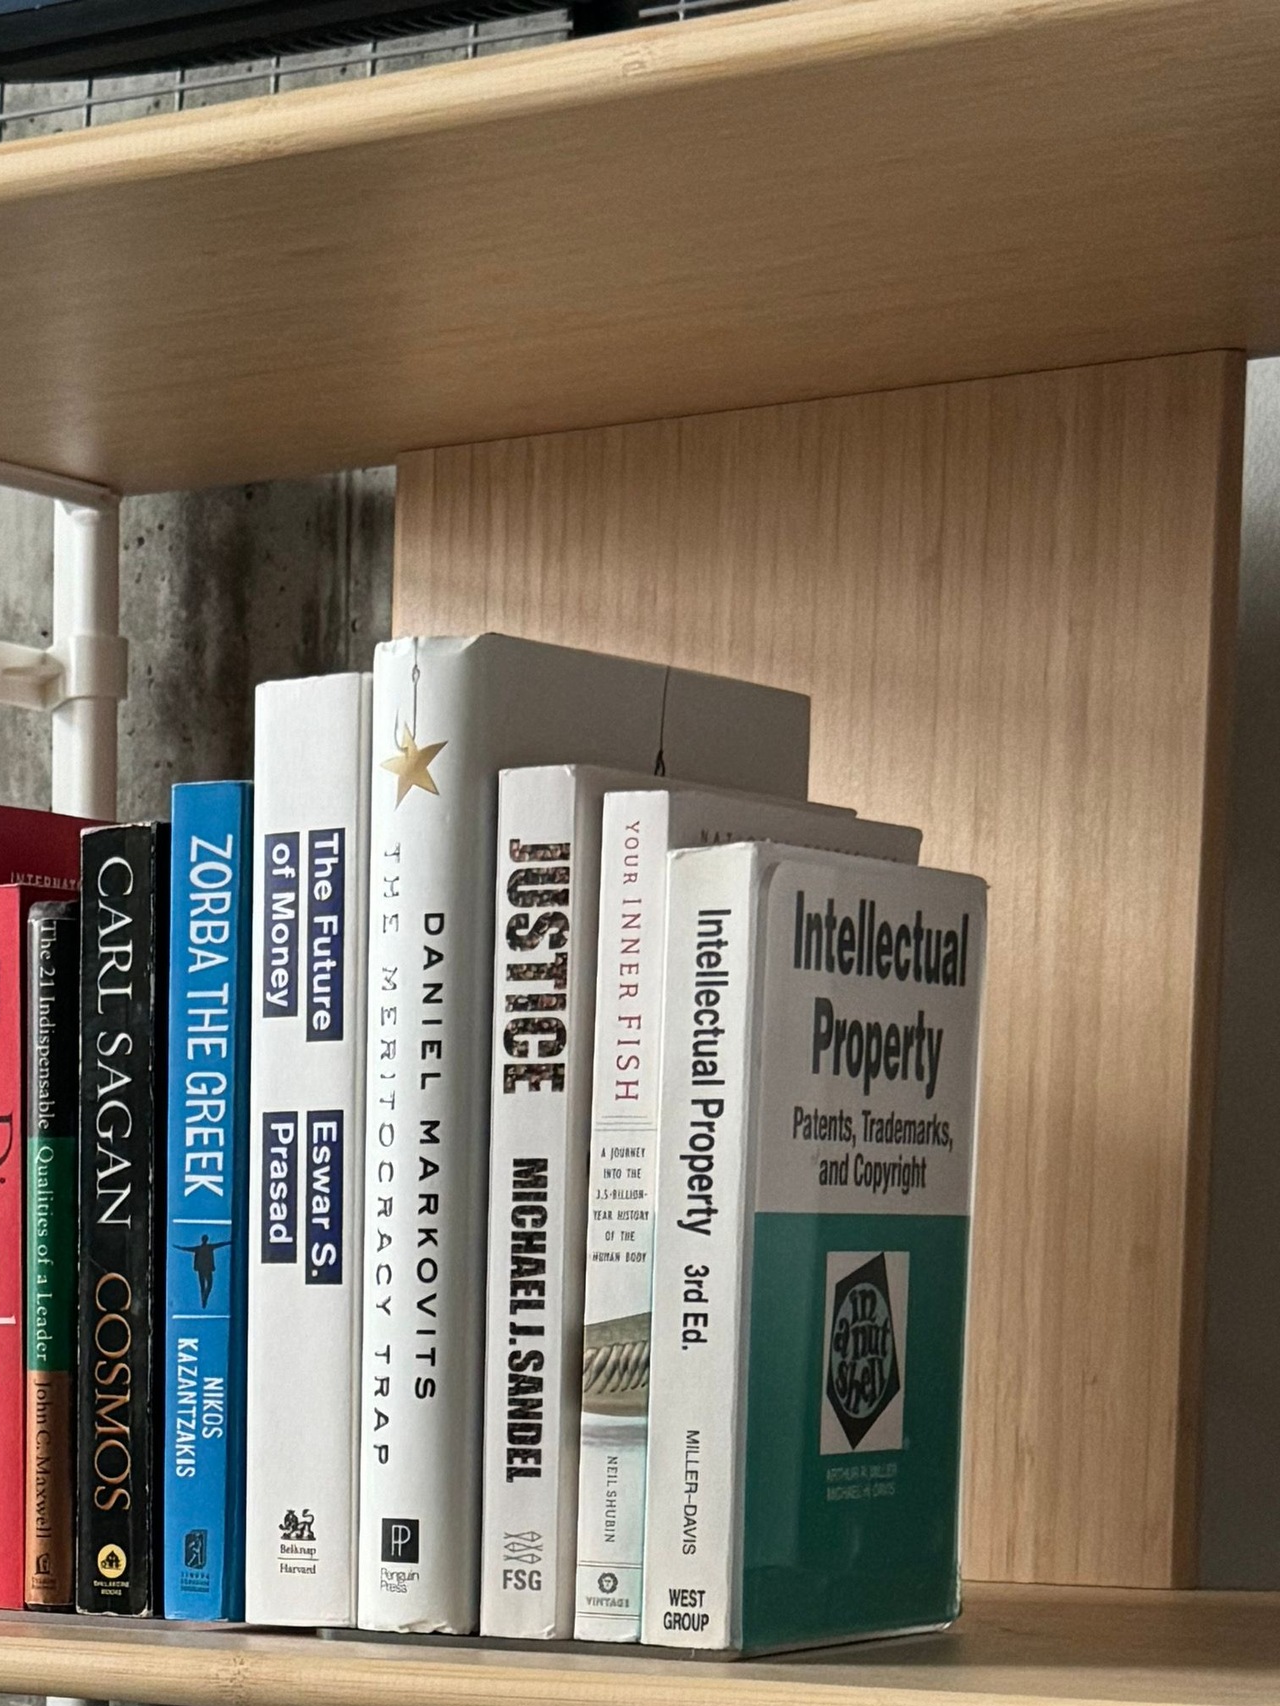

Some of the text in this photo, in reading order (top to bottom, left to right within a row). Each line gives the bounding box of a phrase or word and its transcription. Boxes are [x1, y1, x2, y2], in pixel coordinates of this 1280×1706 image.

[266, 843, 296, 1008] of Money
[312, 832, 339, 1031] The Future
[502, 838, 571, 1095] JUSTICE
[615, 820, 643, 1102] YOUR INNER FISH
[793, 889, 970, 988] Intellectual
[96, 856, 134, 1229] CARL SAGAN
[184, 834, 233, 1198] ZORBA THE GREEK
[812, 997, 943, 1100] Property
[35, 919, 58, 1362] The 21 Indispensable Qualities of a Leader
[372, 843, 402, 1466] THE MERITOCRACY TRAP
[415, 912, 446, 1400] DANIEL MARKOVITS
[600, 1147, 646, 1160] A JOURNEY
[603, 1167, 642, 1179] INTO THE
[677, 908, 732, 1351] Intellectual Property 3rd Ed.
[792, 1105, 954, 1151] Patents, Trademarks,
[819, 1153, 927, 1195] and Copyright
[268, 1122, 295, 1245] Prasad
[311, 1121, 338, 1278] Eswar S.
[593, 1209, 650, 1221] YEAR HISTORY
[509, 1157, 549, 1315] MICHAEL
[592, 1251, 647, 1263] HUMAN BODY
[605, 1230, 636, 1242] OF THE
[833, 1317, 891, 1361] a nut
[848, 1288, 877, 1323] in
[94, 1272, 132, 1512] COSMOS
[175, 1338, 200, 1479] KAZANTZAKIS
[202, 1377, 224, 1440] NIKOS
[33, 1380, 53, 1540] John C. Maxwell
[604, 1455, 619, 1544] NEIL SHUBIN
[279, 1563, 317, 1575] Harvard
[379, 1580, 408, 1593] Press
[380, 1567, 420, 1583] Penguin
[502, 1568, 543, 1592] FSG
[586, 1596, 630, 1609] VINTAGE
[668, 1588, 706, 1609] WEST
[663, 1612, 710, 1632] GROUP
